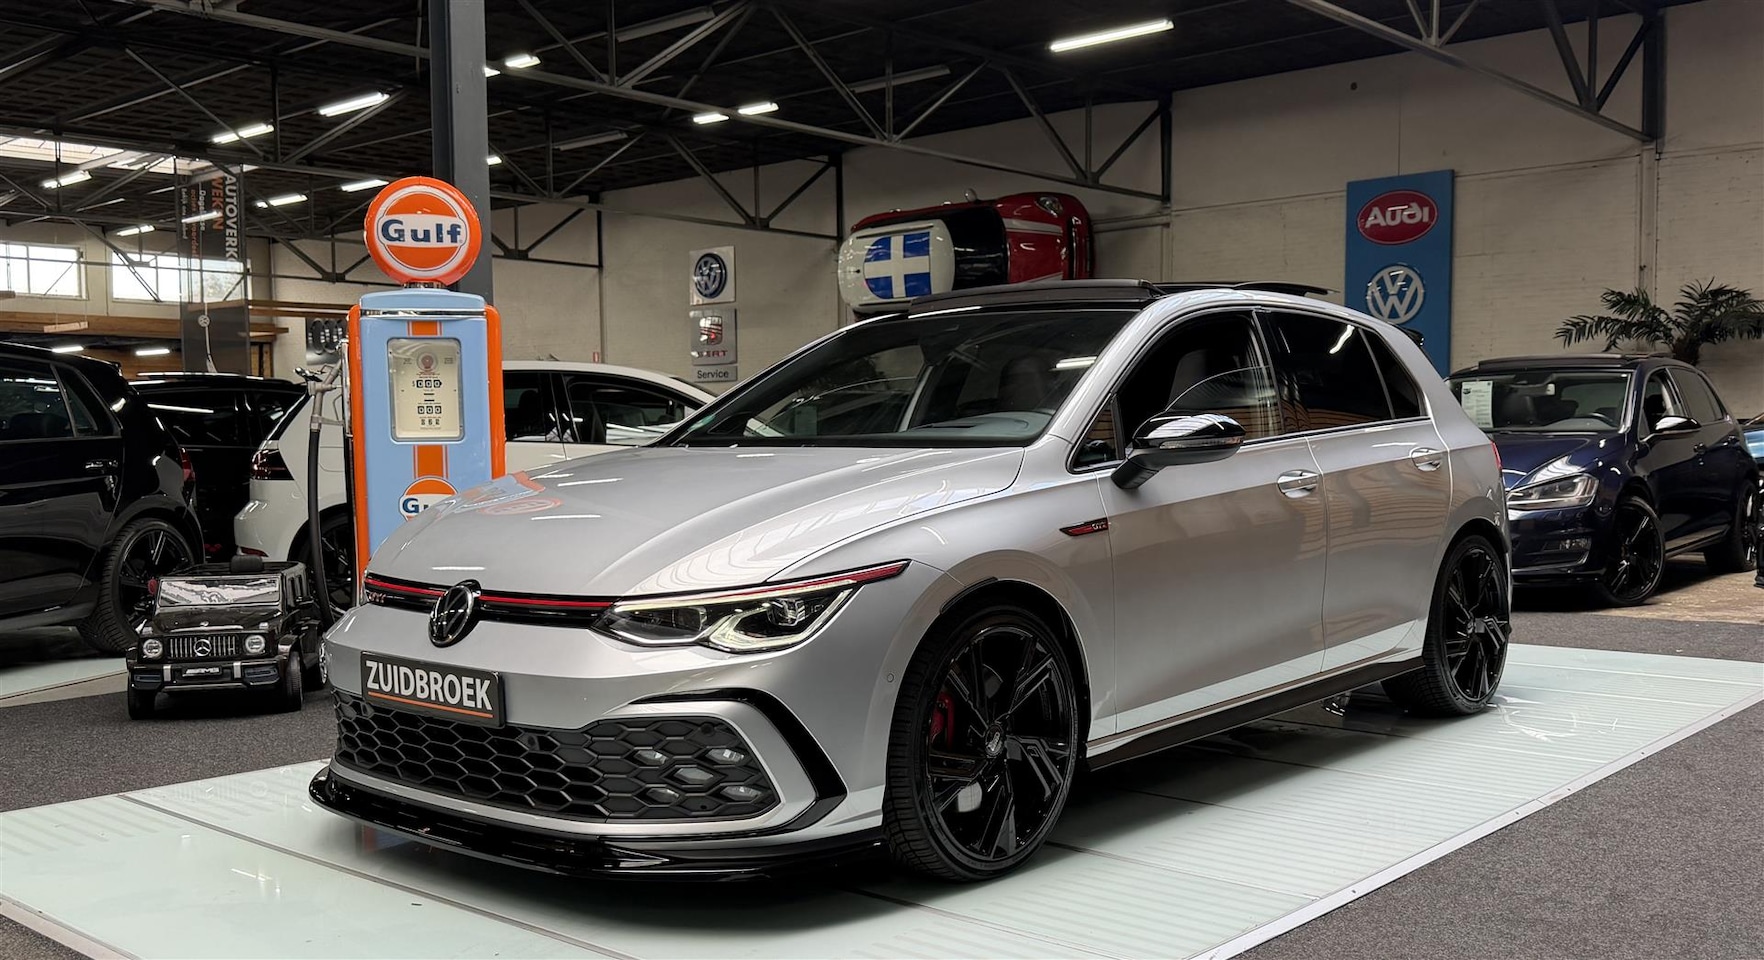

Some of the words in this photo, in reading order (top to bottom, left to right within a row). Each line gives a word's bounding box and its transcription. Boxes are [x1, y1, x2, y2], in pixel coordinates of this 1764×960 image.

[381, 219, 461, 244] Gulf
[697, 369, 729, 380] Service
[365, 660, 493, 710] ZUIDBROEK
